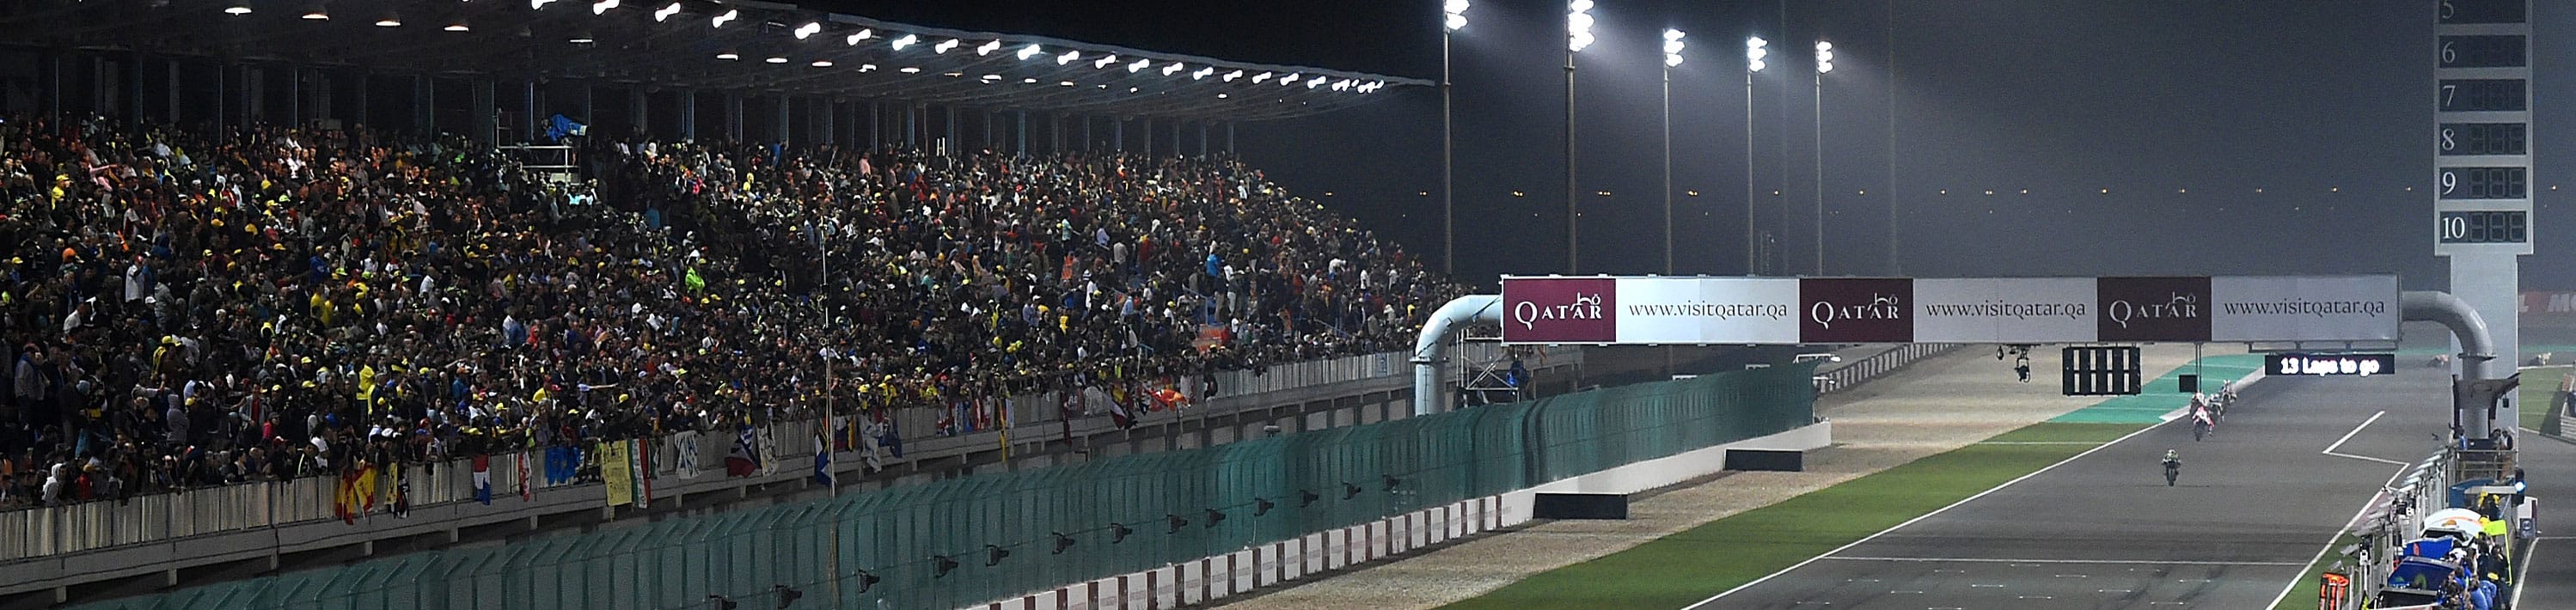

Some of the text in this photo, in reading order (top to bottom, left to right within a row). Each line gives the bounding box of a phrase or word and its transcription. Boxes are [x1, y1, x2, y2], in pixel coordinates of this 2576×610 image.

[2442, 0, 2454, 19] 5
[2442, 41, 2456, 64] 6
[2442, 84, 2457, 107] 7
[2442, 128, 2456, 151] 8
[2442, 171, 2457, 195] 9
[2443, 217, 2465, 240] 10
[1514, 295, 1602, 330] QATAR
[1629, 299, 1787, 321] www.visitqatar.qa
[1811, 295, 1899, 330] QATAR
[1926, 299, 2085, 320] www.visitqatar.qa
[2109, 295, 2197, 329] QATAR
[2224, 297, 2384, 318] www.visitqatar.qa
[2280, 357, 2379, 376] 13 Laps to go
